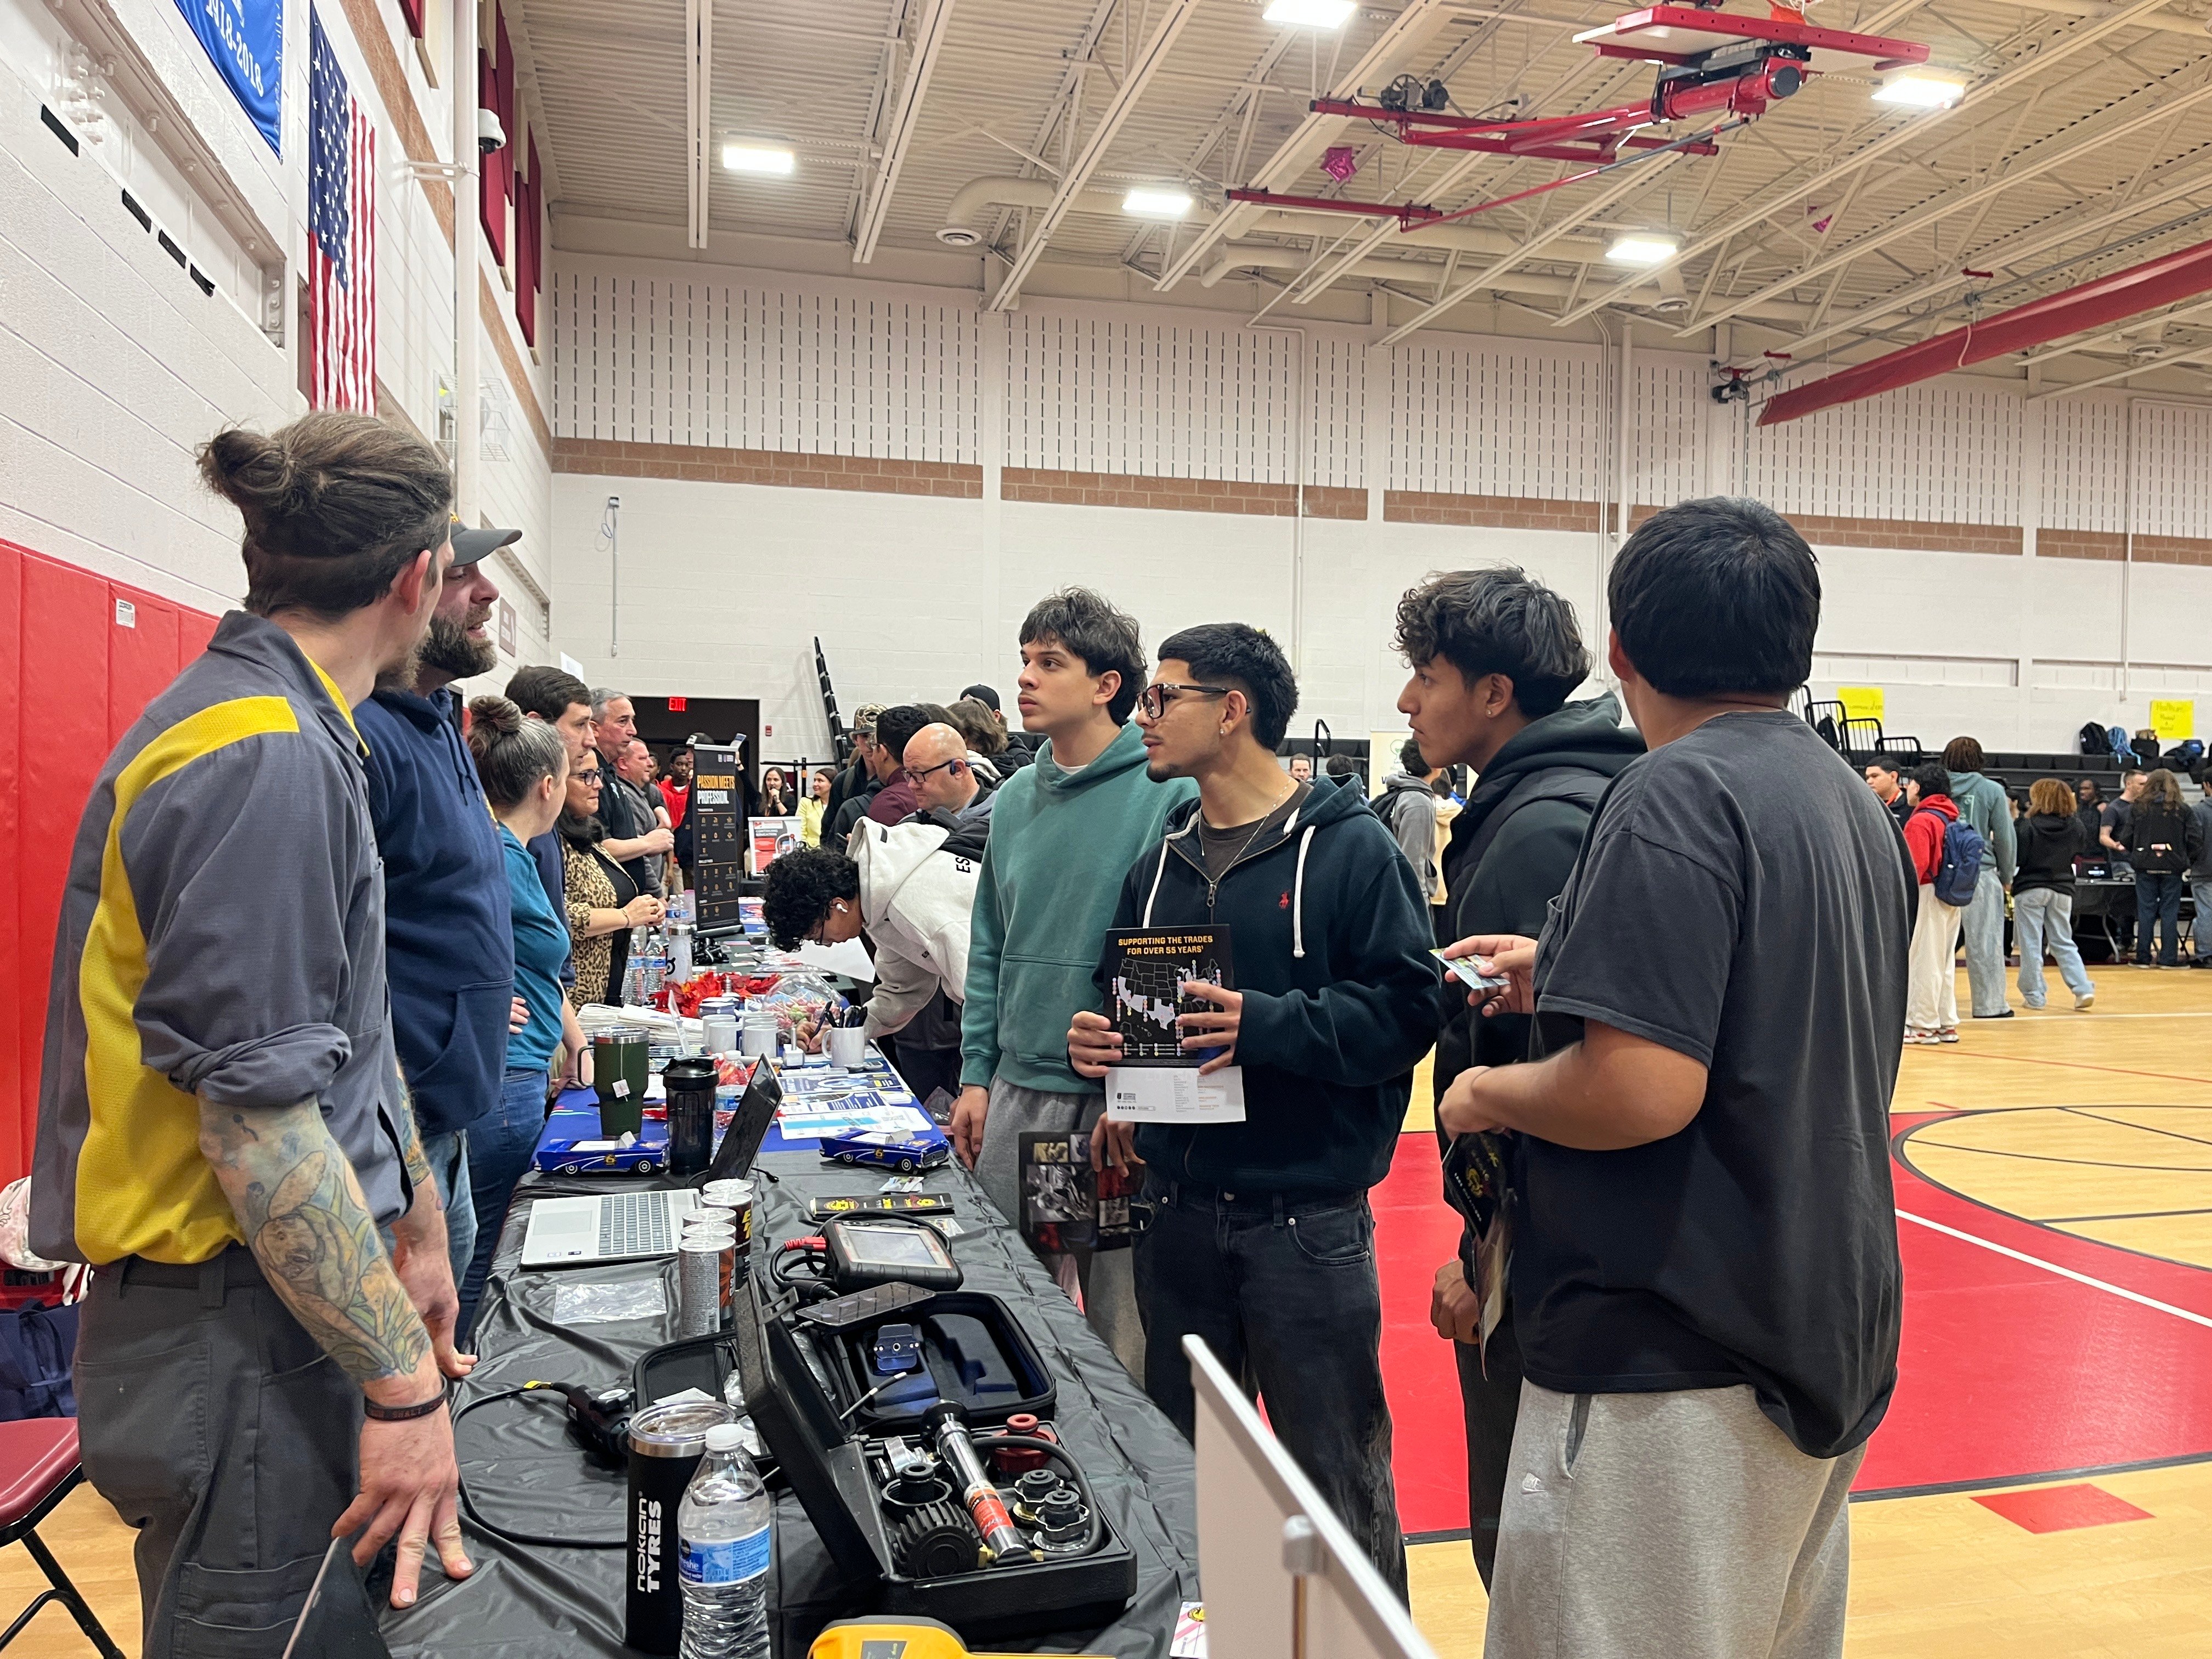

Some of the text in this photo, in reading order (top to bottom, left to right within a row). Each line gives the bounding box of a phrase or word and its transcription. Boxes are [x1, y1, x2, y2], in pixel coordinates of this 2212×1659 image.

[668, 697, 686, 712] EXIT
[697, 775, 735, 789] PASSION MEETS
[697, 791, 730, 804] PROFESSION.
[1118, 935, 1213, 946] SUPPORTING THE TRADES
[1127, 947, 1142, 955] FOR
[1143, 946, 1164, 955] OVER
[637, 1498, 647, 1592] nokian
[647, 1500, 662, 1593] TYRES
